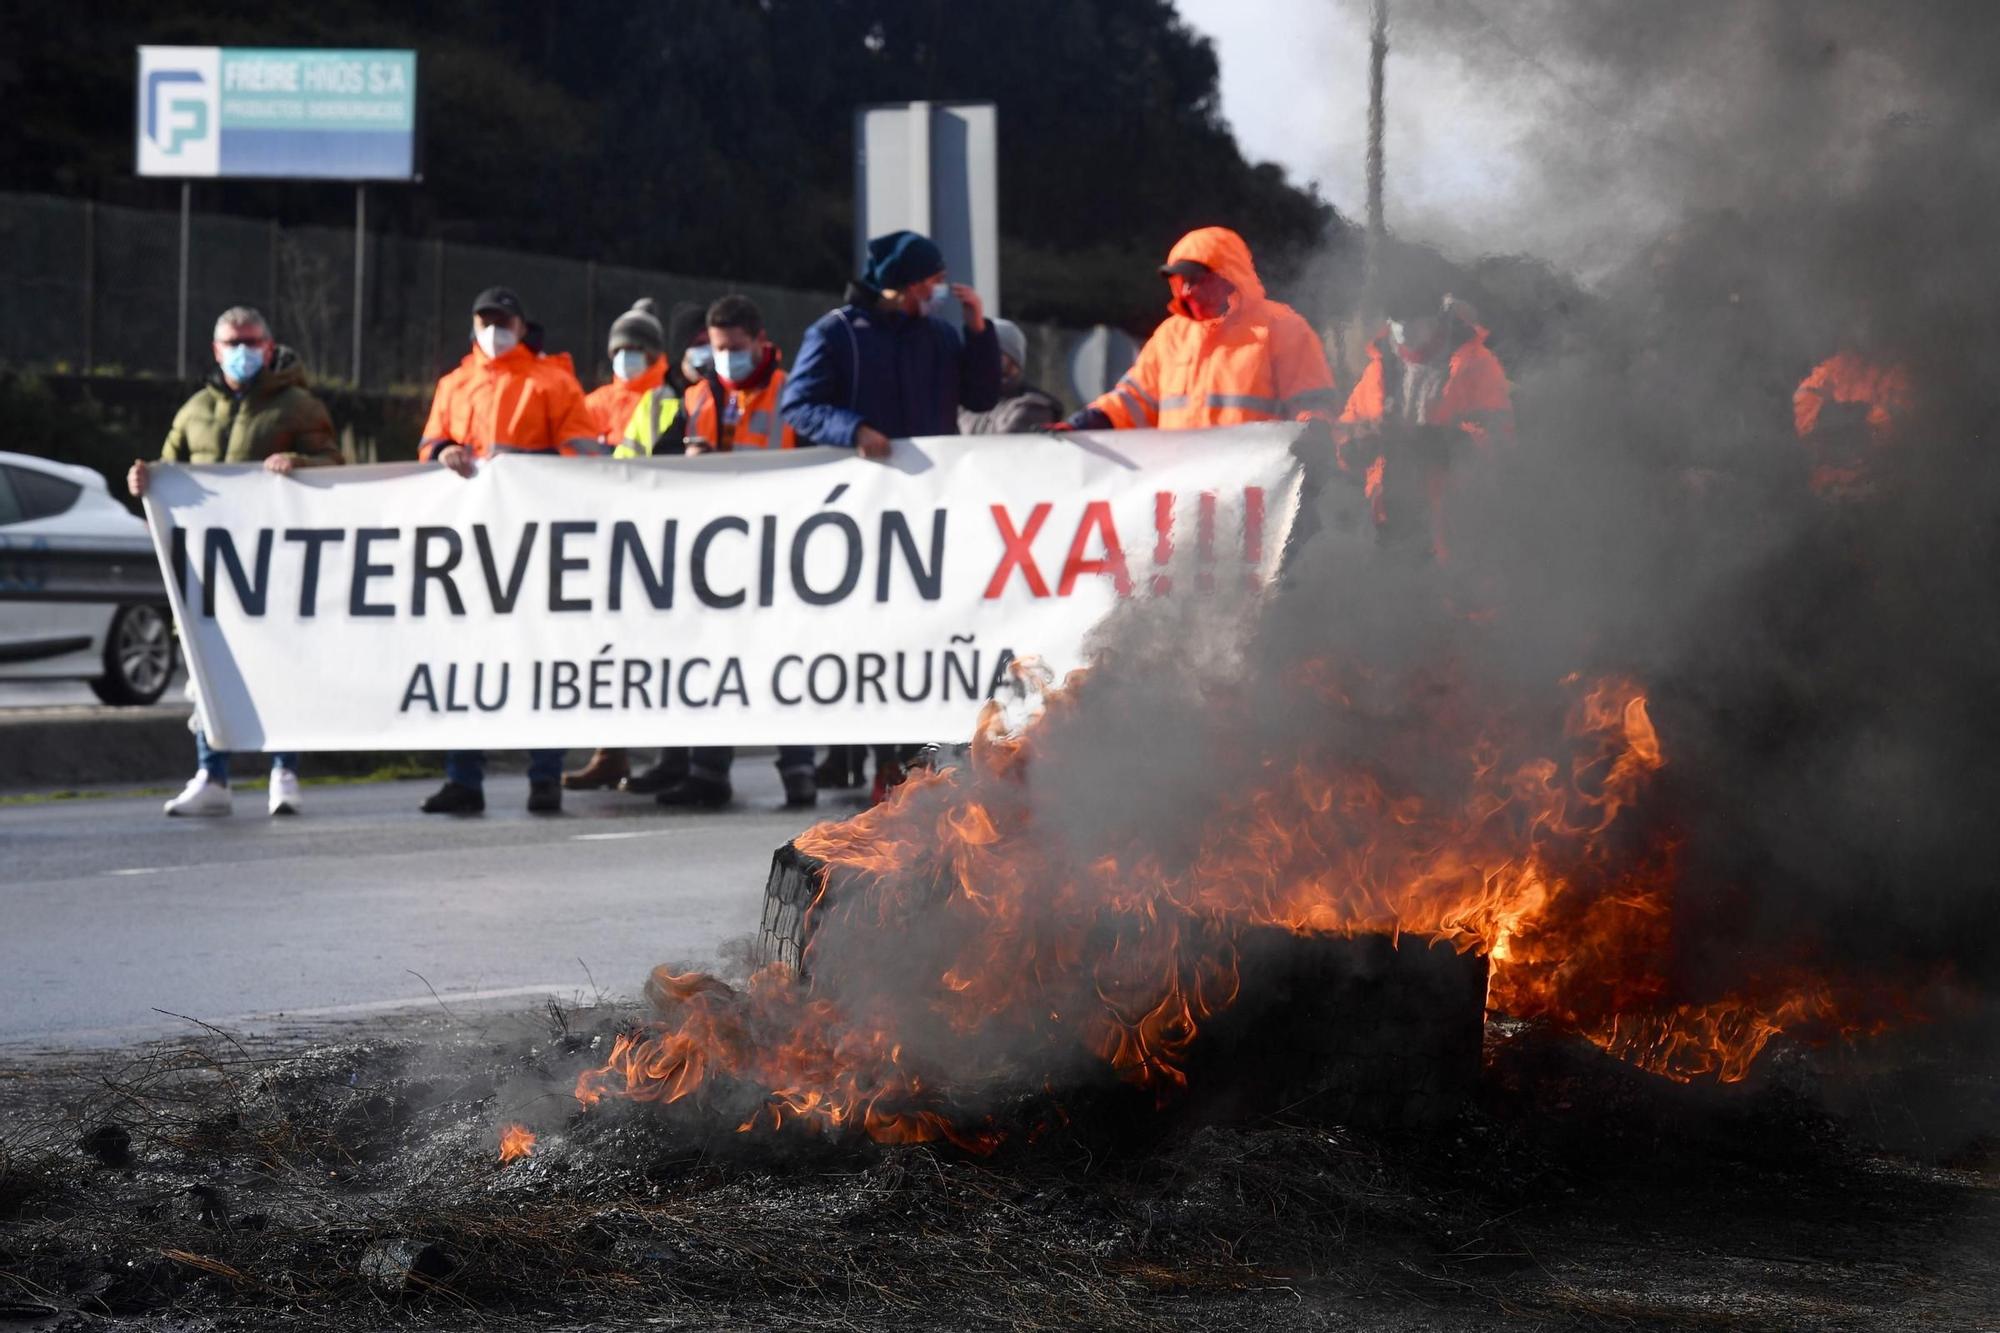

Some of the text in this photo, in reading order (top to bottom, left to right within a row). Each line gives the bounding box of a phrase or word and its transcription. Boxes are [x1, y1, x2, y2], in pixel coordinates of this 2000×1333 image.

[172, 484, 948, 618] INTERVENCIÓN
[984, 486, 1266, 599] XA!!!
[400, 633, 1028, 714] ALU IBÉRICA CORUÑA
